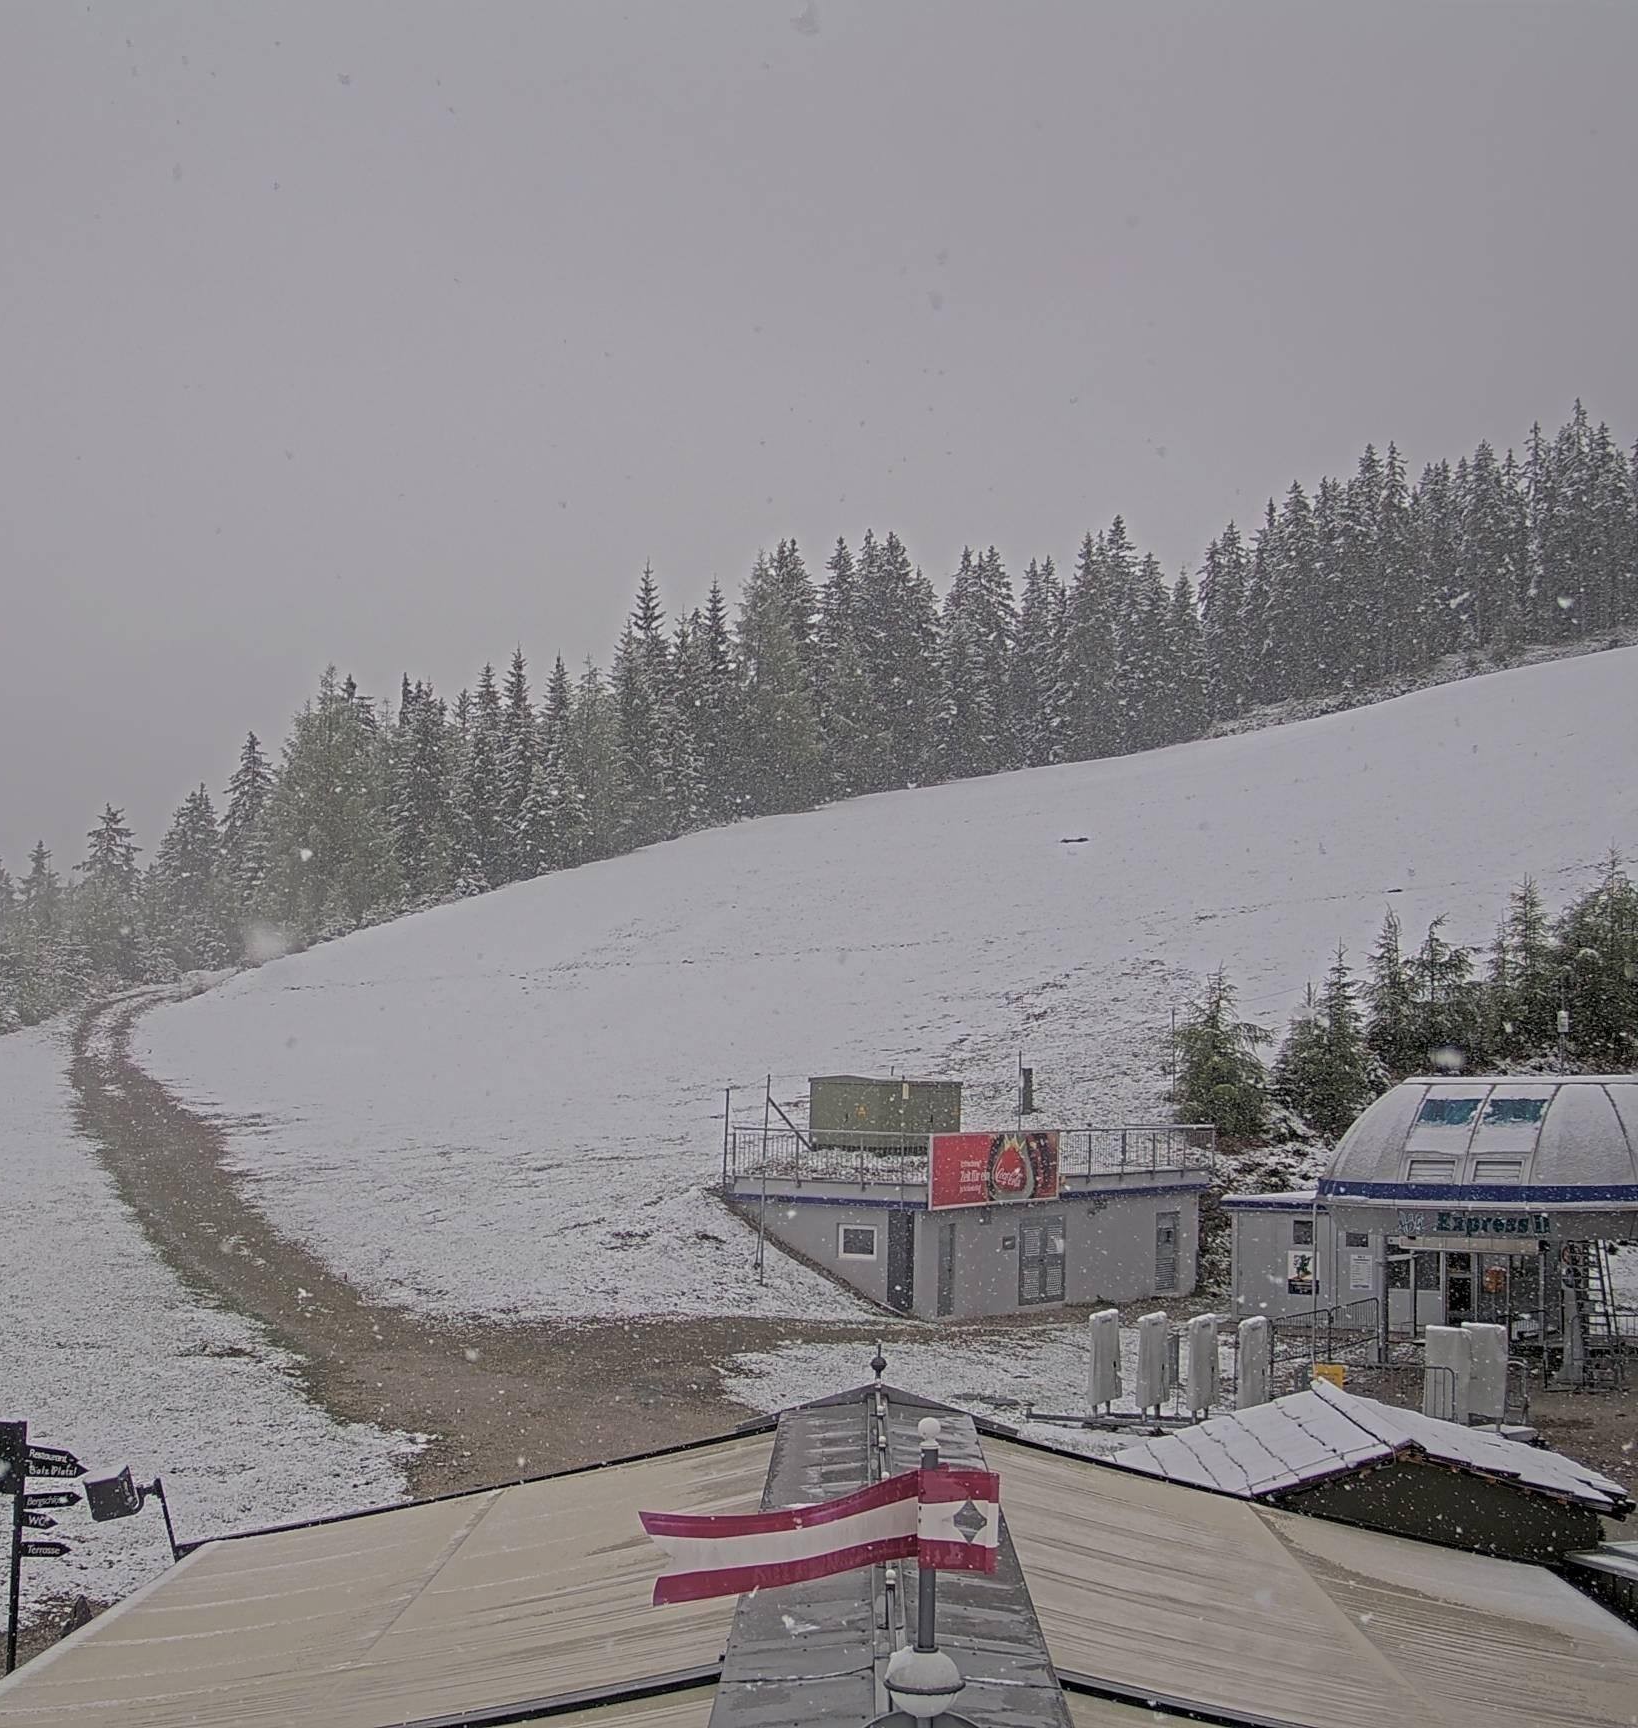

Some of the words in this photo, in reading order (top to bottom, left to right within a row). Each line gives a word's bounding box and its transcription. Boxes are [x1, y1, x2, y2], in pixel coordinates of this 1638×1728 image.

[1437, 1212, 1529, 1237] Express
[28, 1515, 45, 1527] WC
[27, 1544, 61, 1555] Terrasse
